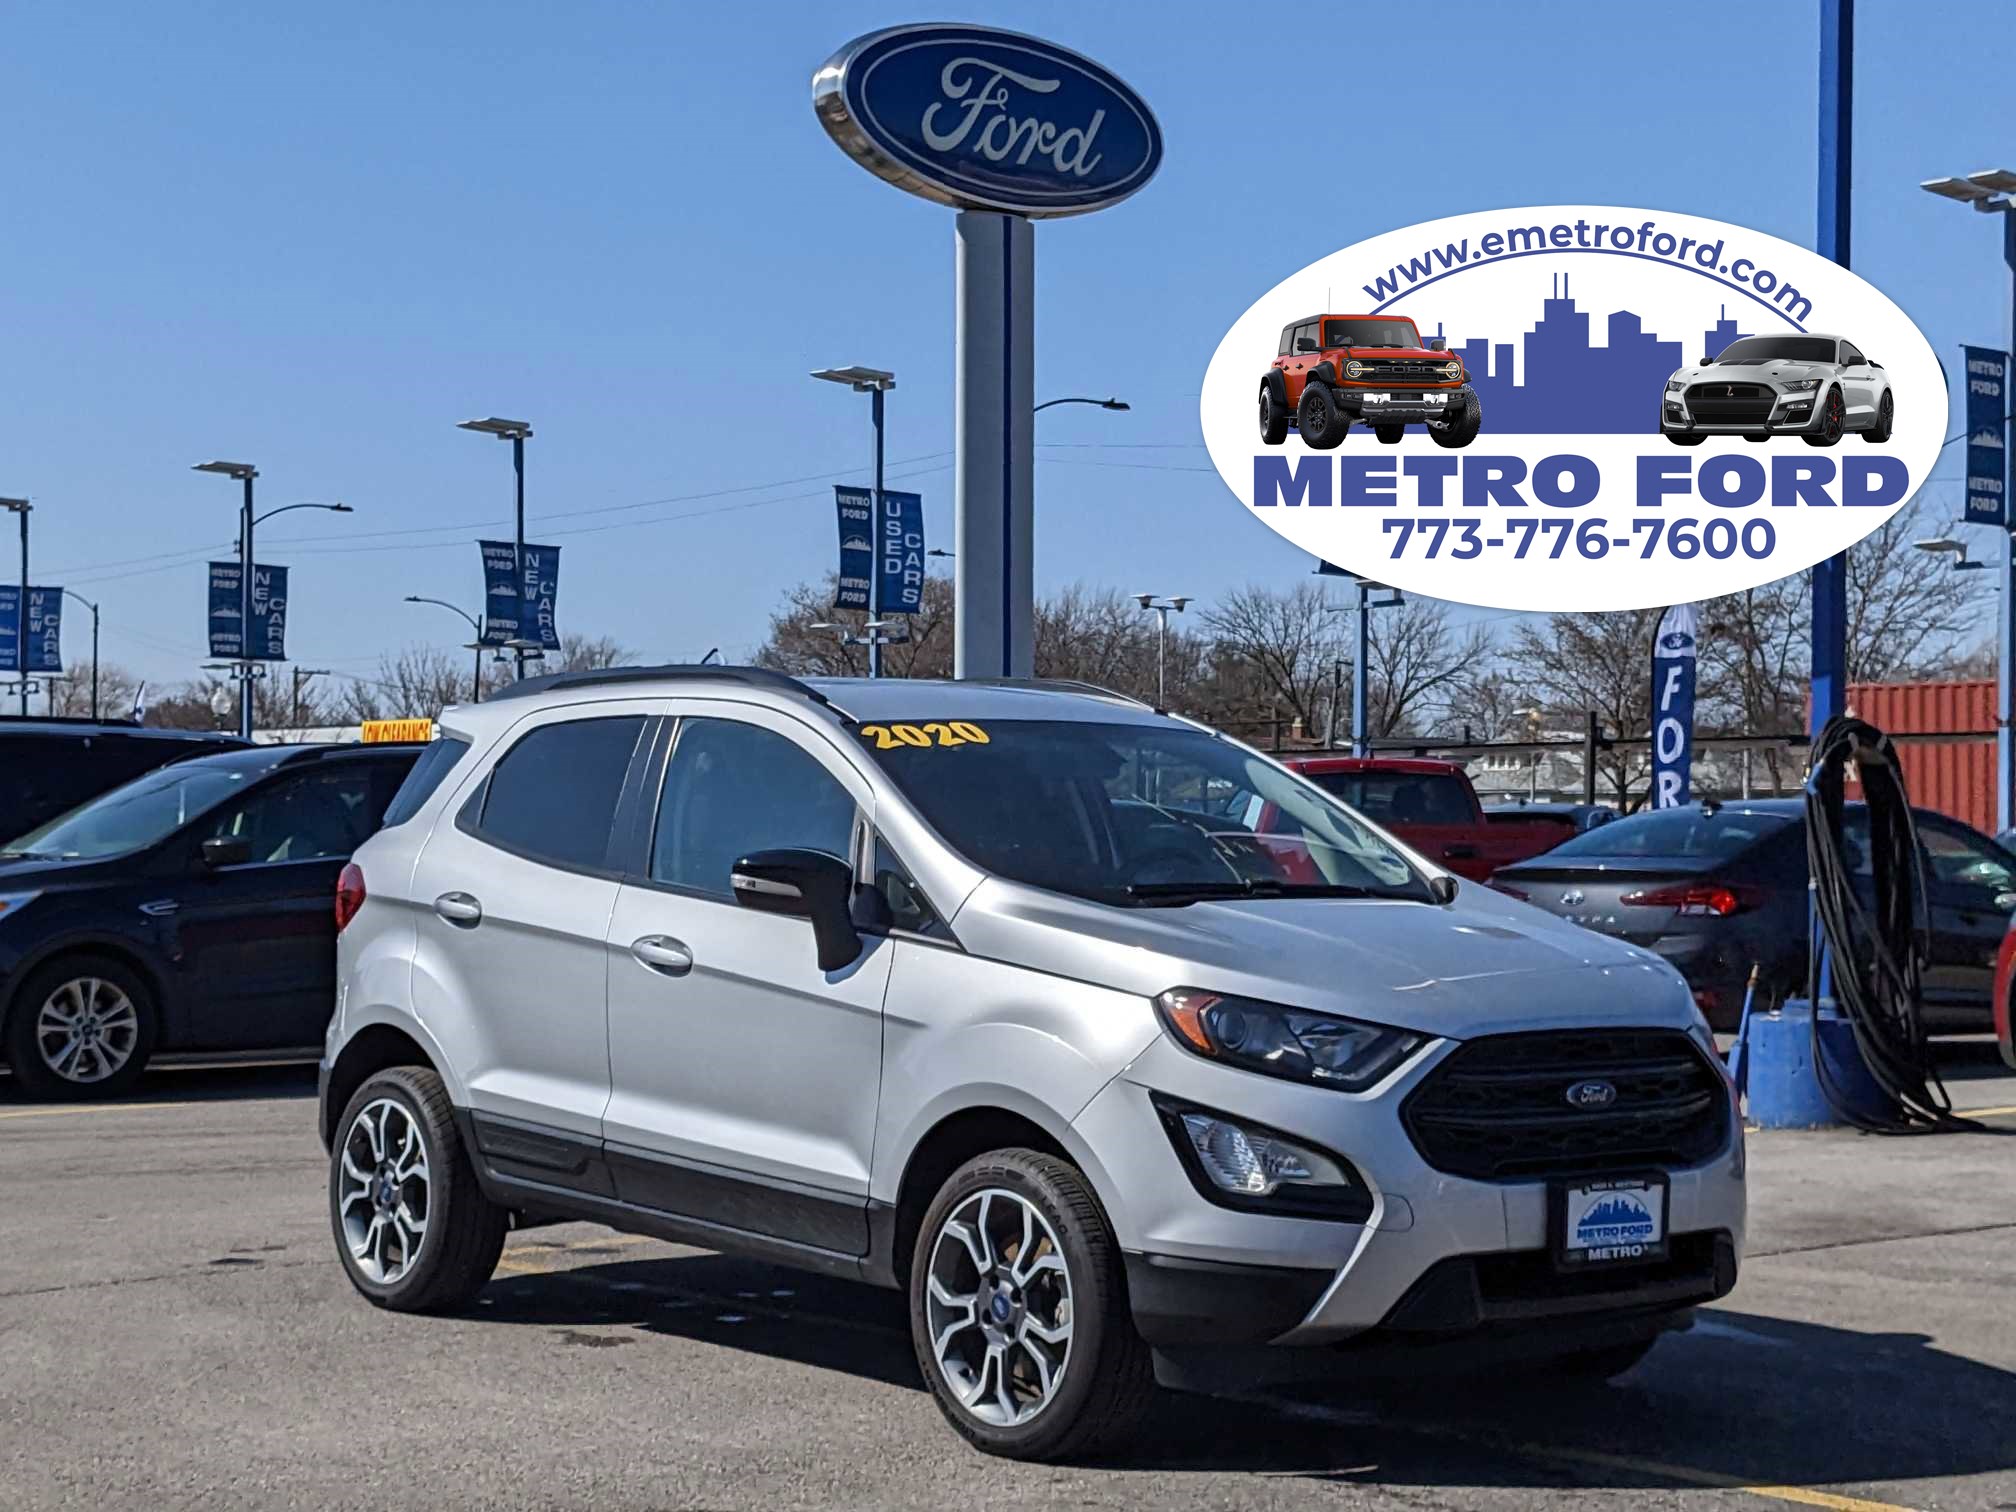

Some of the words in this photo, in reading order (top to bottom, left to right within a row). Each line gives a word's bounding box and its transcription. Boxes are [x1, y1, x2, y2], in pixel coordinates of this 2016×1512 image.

[921, 57, 1105, 176] Ford
[1968, 360, 2003, 377] METRO
[1971, 380, 2000, 396] FORD
[838, 494, 870, 507] METRO
[1970, 497, 1998, 512] FORD
[842, 508, 868, 520] FORD
[885, 501, 902, 574] USED
[525, 553, 539, 600] NEW
[902, 533, 921, 604] CARS
[255, 572, 271, 616] NEW
[840, 577, 870, 589] METRO
[841, 592, 867, 603] FORD
[30, 592, 44, 632] NEW
[538, 581, 555, 641] CARS
[267, 598, 285, 654] CARS
[43, 615, 58, 666] CARS
[860, 721, 990, 749] 2020
[1580, 1084, 1608, 1103] Ford
[1577, 1226, 1619, 1239] METRO
[1620, 1224, 1653, 1236] FORD
[1588, 1244, 1643, 1262] METRO
